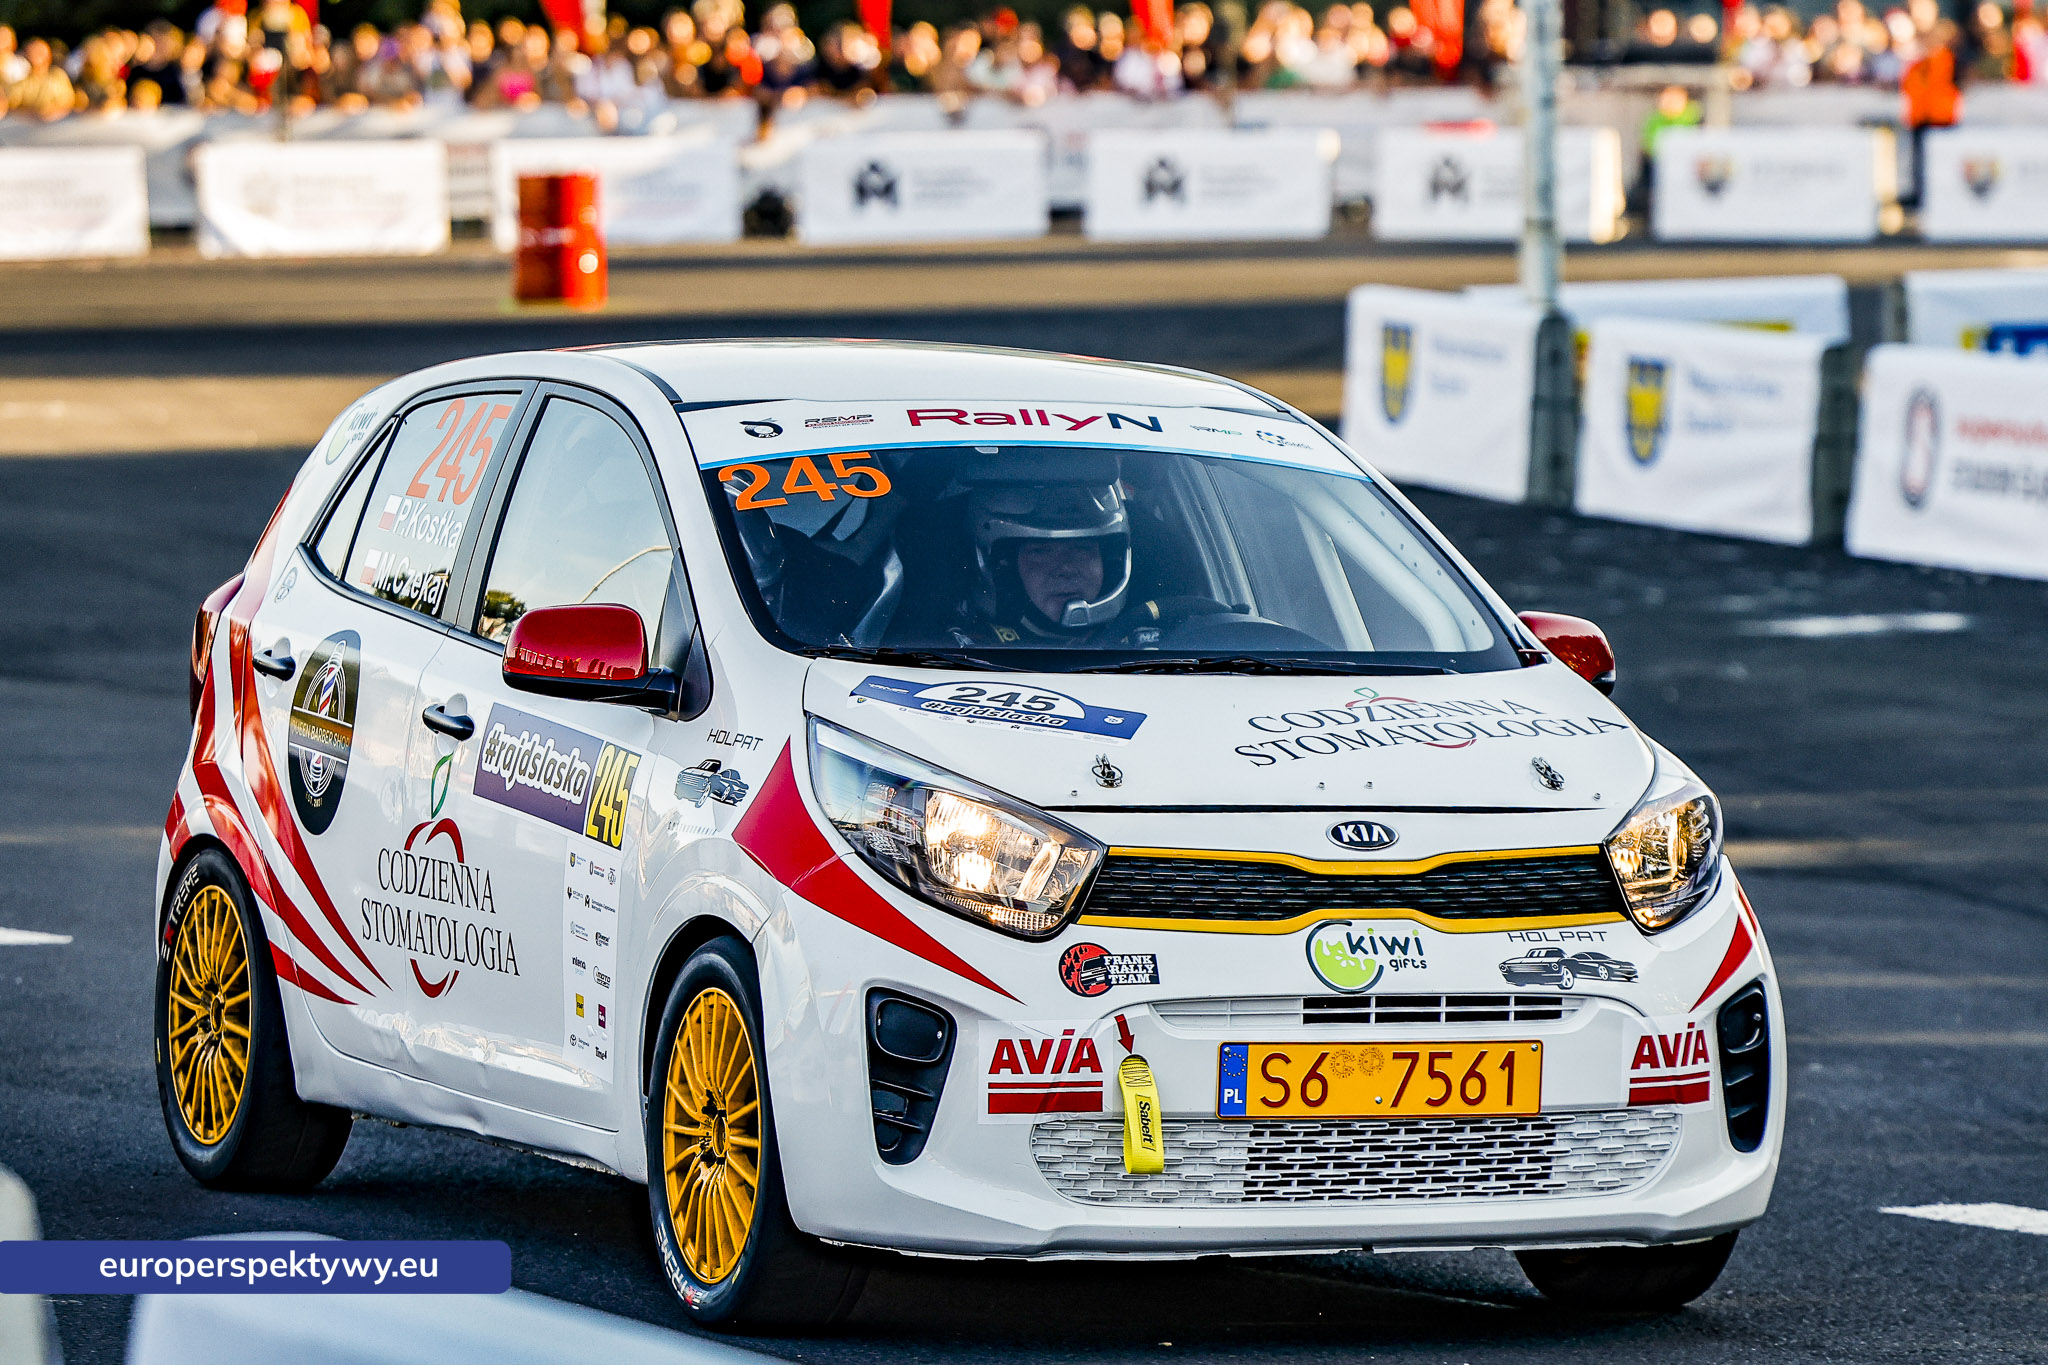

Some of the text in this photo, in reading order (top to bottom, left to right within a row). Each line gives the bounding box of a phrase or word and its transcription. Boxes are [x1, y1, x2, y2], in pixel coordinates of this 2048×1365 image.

[405, 398, 513, 505] 245
[717, 451, 892, 511] 245
[392, 498, 464, 550] P.Kostka
[374, 552, 450, 616] M.Czekaj
[924, 701, 1069, 726] #rajdslaska
[948, 686, 1061, 712] 245
[1248, 698, 1548, 734] CODZIENNA
[706, 728, 764, 751] HOLPAT
[1234, 715, 1629, 768] STOMATOLOGIA
[484, 729, 588, 798] #rajdslaska
[586, 744, 641, 847] 245
[1337, 823, 1391, 844] KIA
[377, 848, 496, 914] CODZIENNA
[361, 897, 520, 977] STOMATOLOGIA
[1345, 927, 1425, 957] kiwi
[1507, 931, 1608, 943] HOLPAT
[1103, 955, 1153, 965] FRANK
[1109, 964, 1155, 975] RALLY
[1389, 955, 1428, 972] gifts
[1107, 973, 1151, 984] TEAM
[1223, 1088, 1244, 1104] PL
[1259, 1051, 1330, 1108] S6
[1389, 1050, 1515, 1109] 7561
[1139, 1100, 1154, 1144] Sabelt
